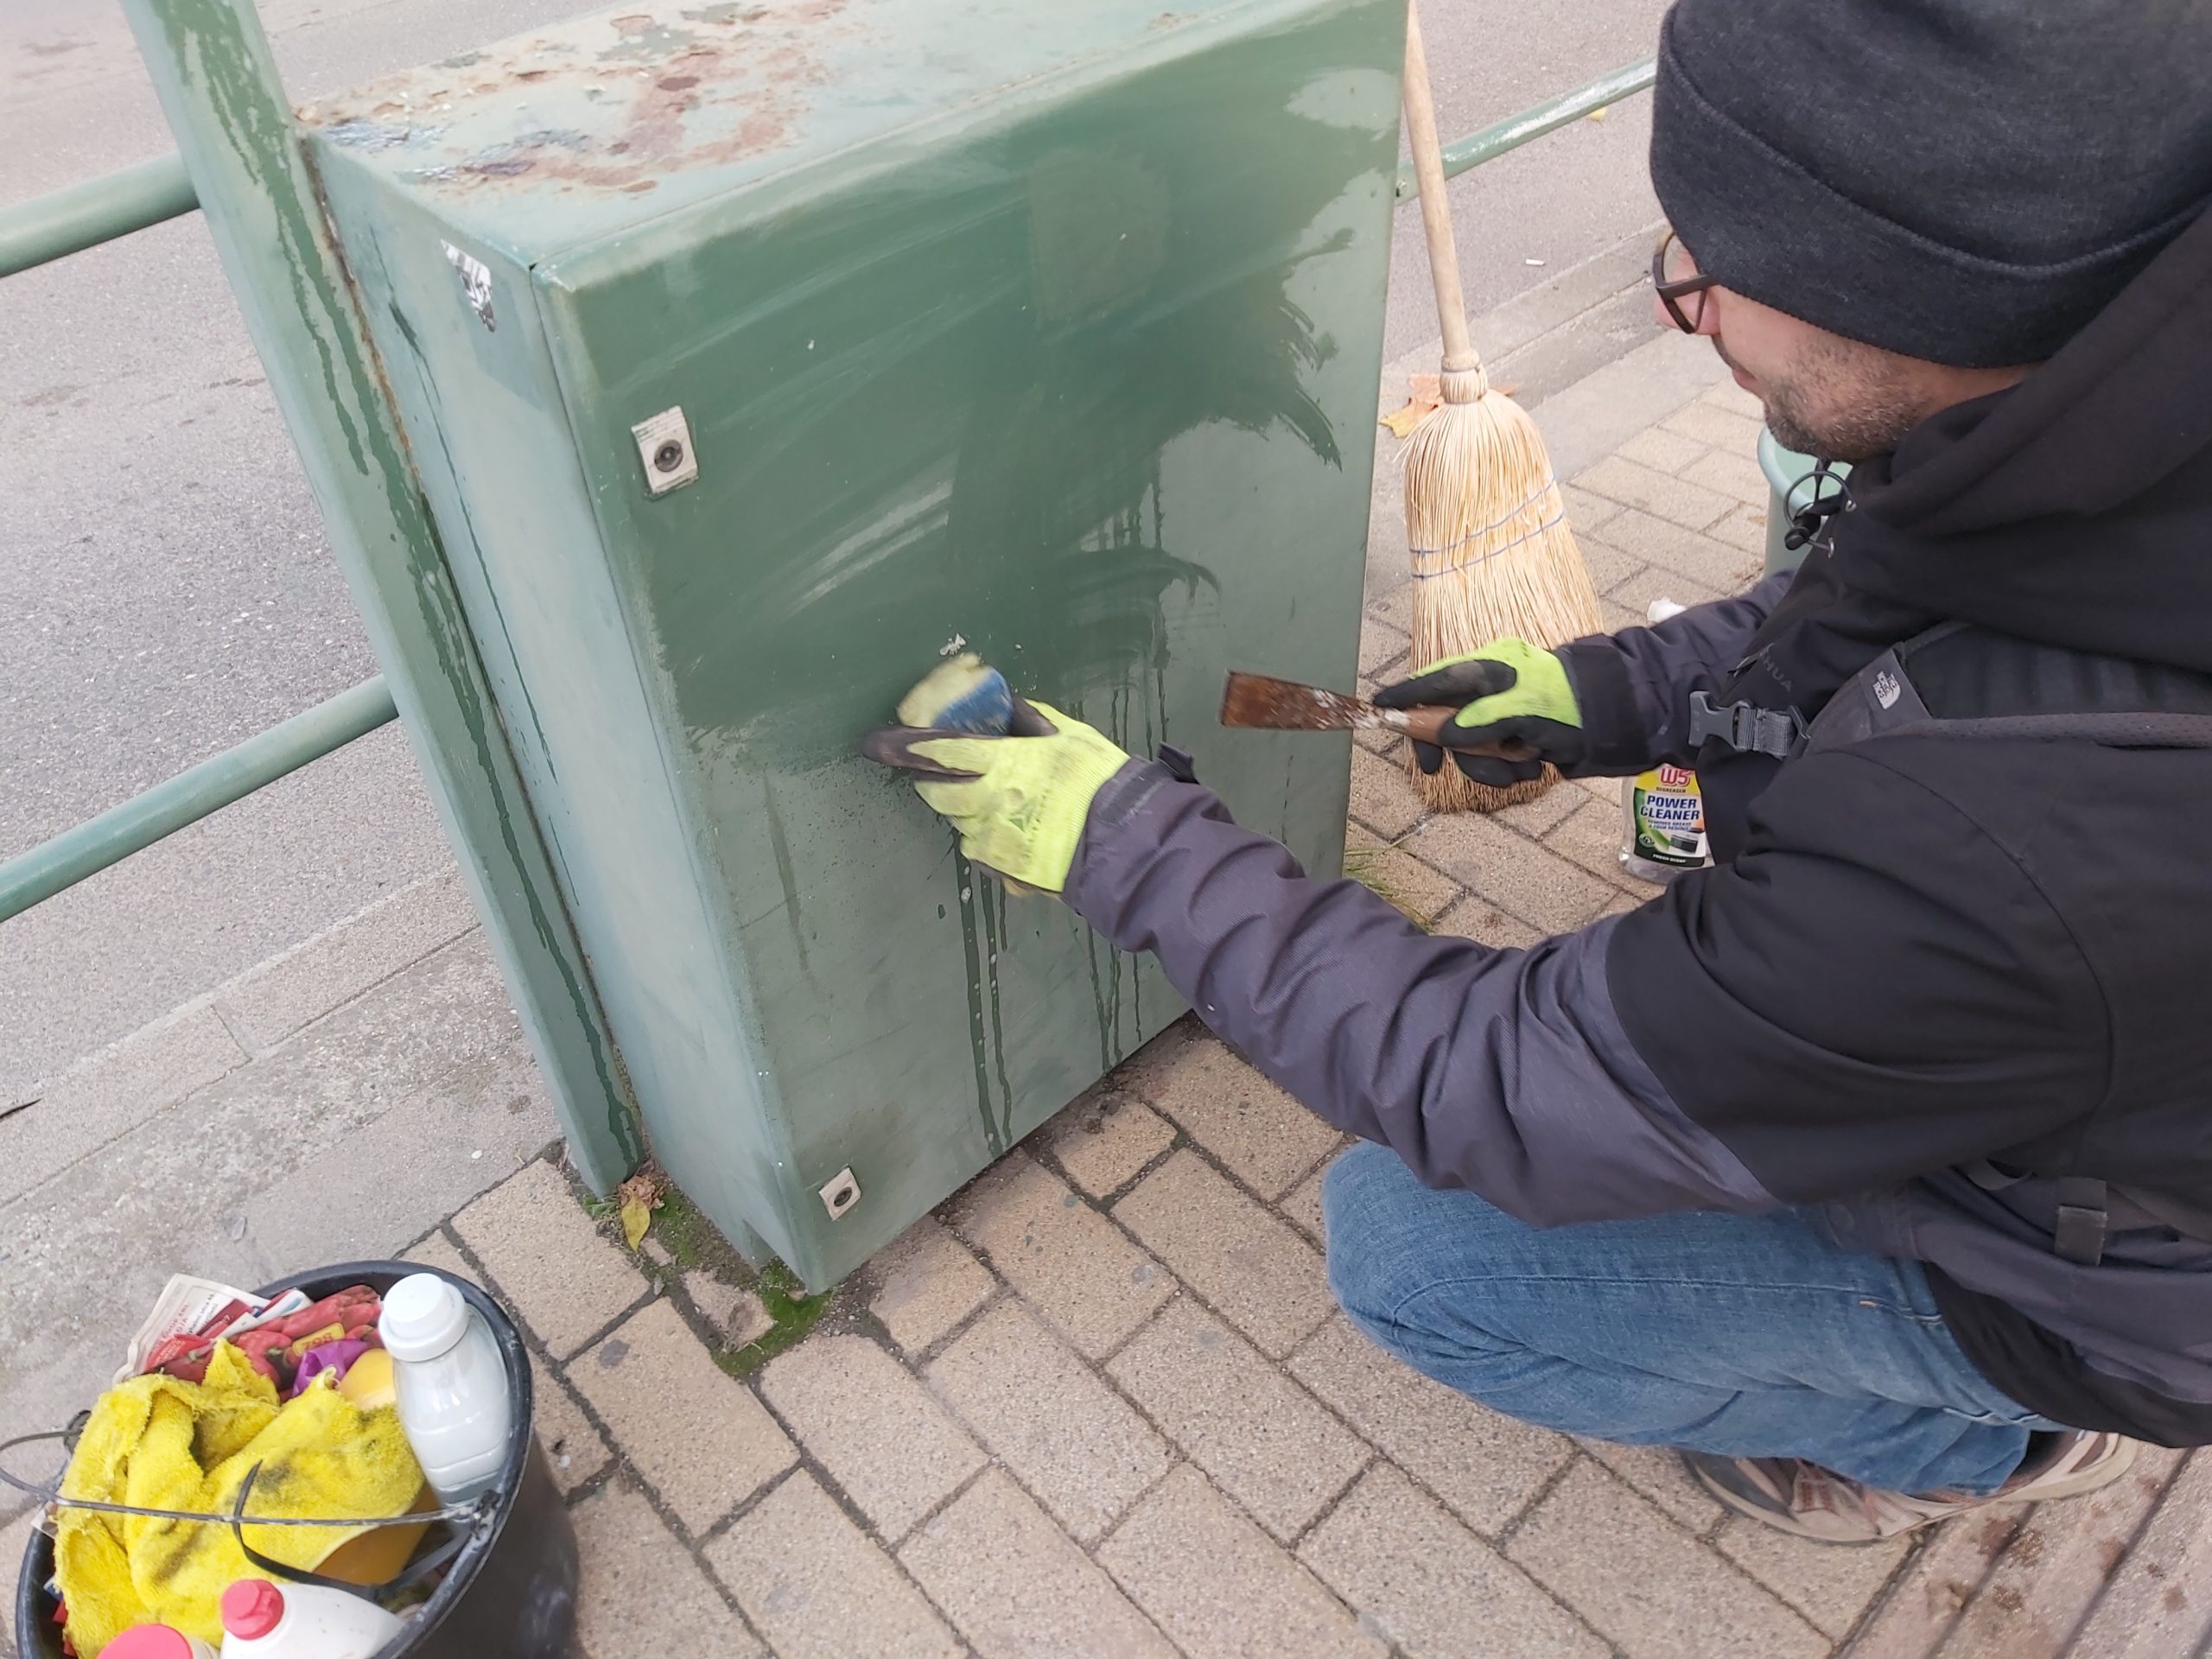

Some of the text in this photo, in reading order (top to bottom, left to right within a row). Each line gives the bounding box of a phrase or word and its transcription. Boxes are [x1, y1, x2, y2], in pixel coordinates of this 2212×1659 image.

[1887, 672, 1898, 689] THE
[1872, 681, 1885, 698] FACE
[1660, 766, 1691, 787] W5
[1647, 795, 1697, 809] POWER
[1640, 806, 1700, 821] CLEANER
